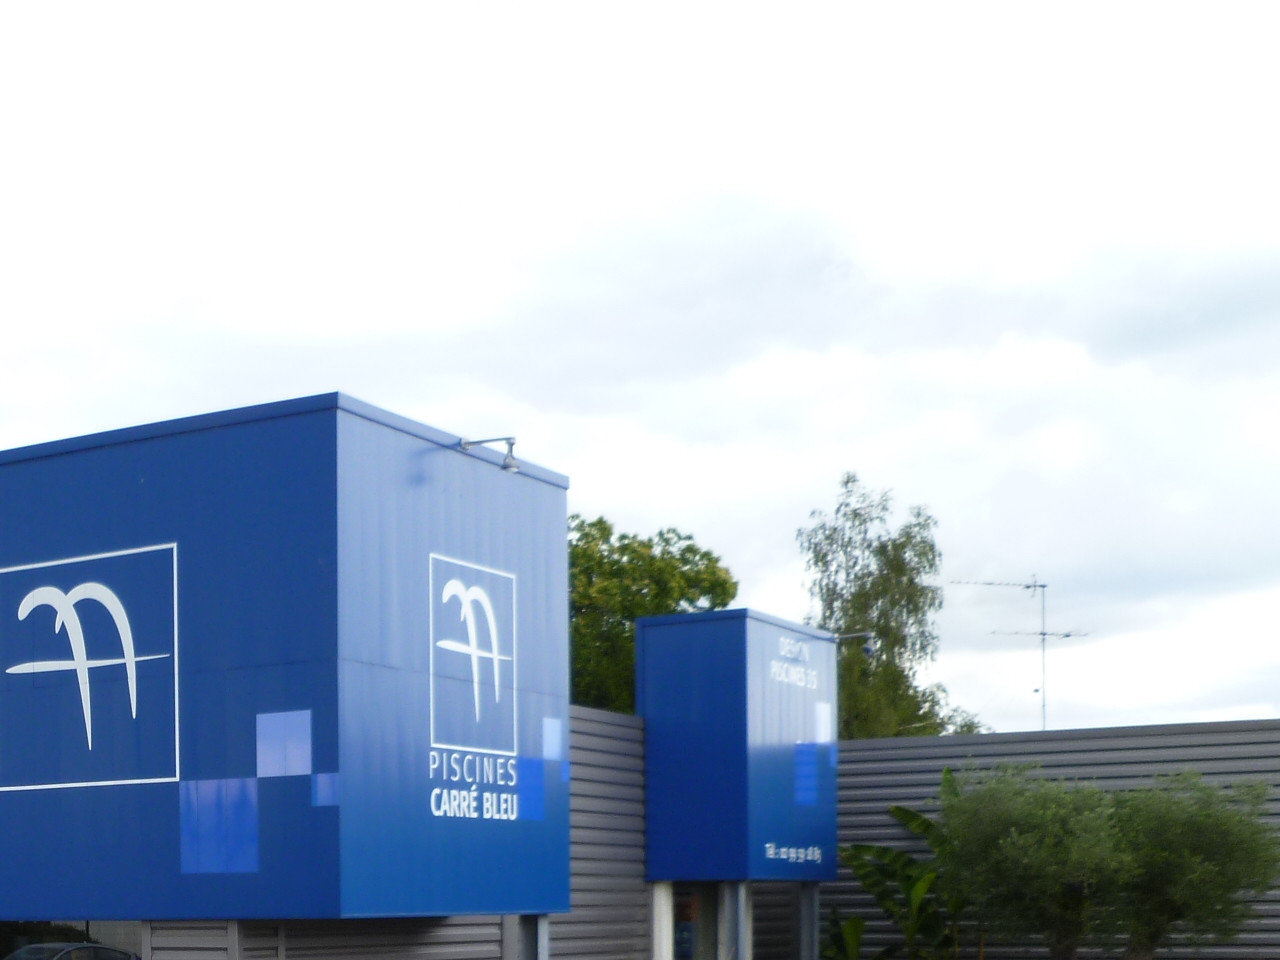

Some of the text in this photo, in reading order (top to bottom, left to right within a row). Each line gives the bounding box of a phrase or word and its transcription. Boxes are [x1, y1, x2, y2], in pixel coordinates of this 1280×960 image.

[429, 751, 518, 786] PISCINES
[430, 784, 518, 821] CARRÉ BLEU
